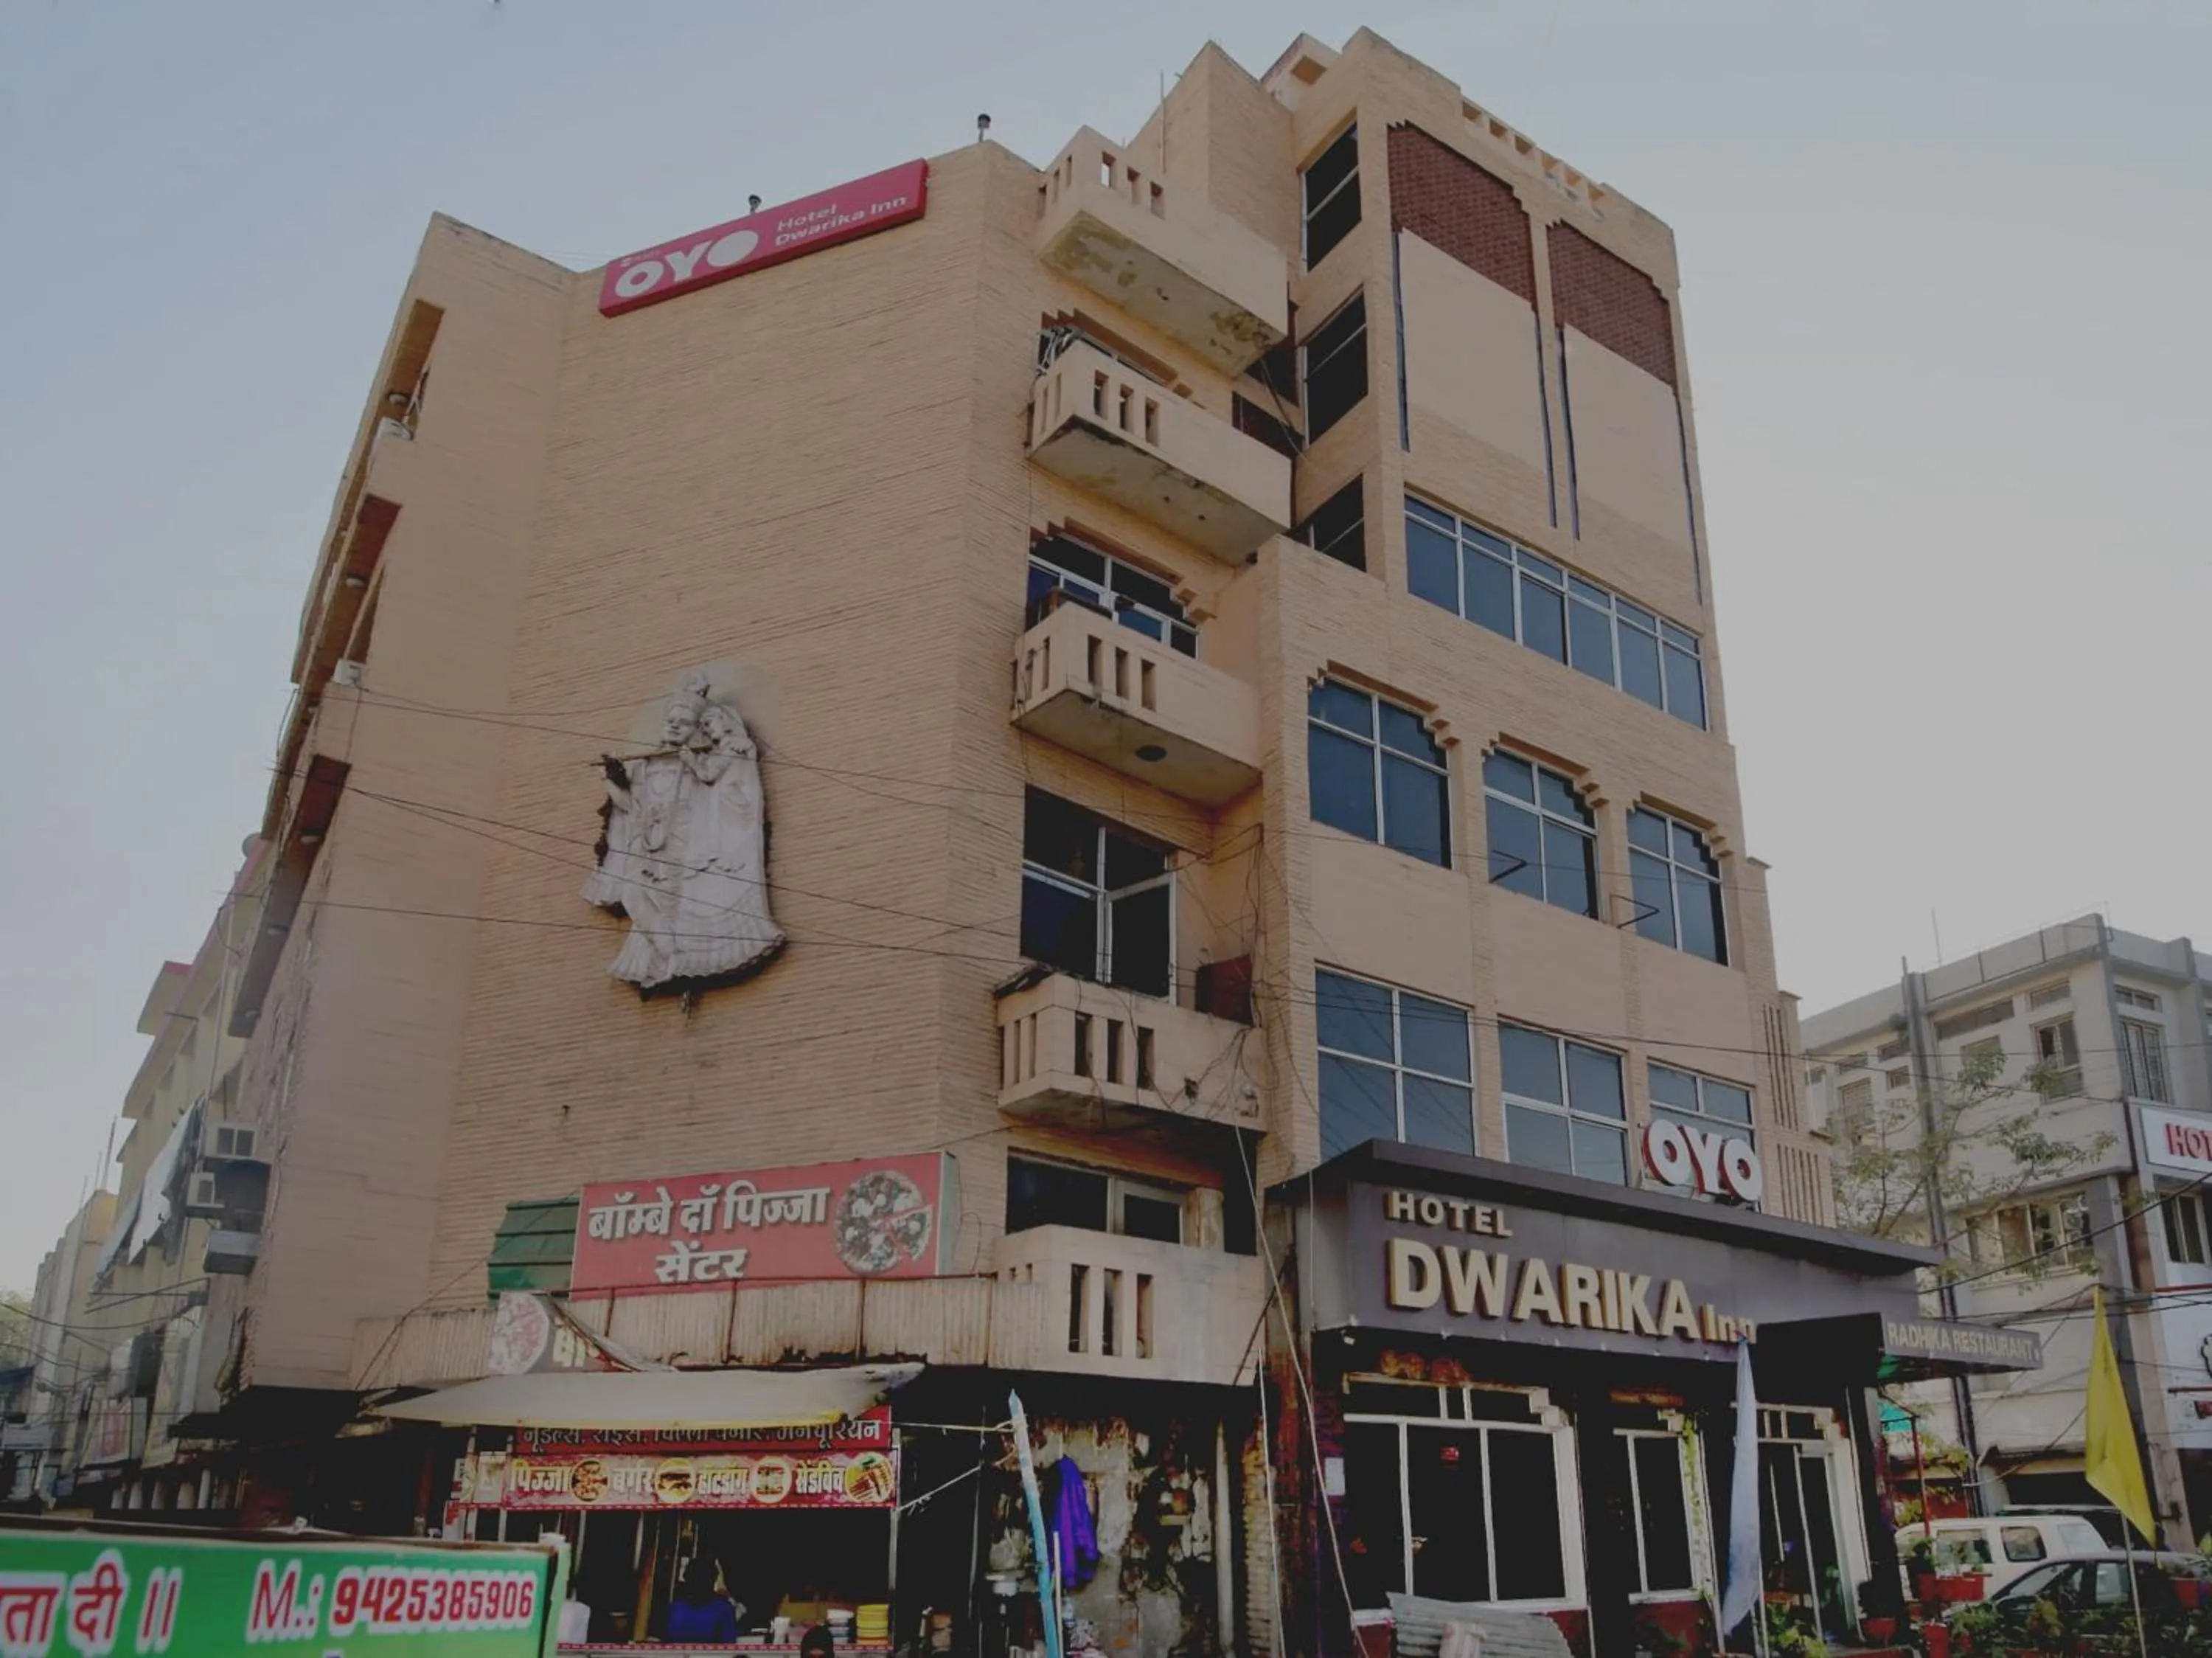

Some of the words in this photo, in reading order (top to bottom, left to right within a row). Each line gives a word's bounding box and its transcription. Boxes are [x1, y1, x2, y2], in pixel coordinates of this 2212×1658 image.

[778, 203, 838, 232] Hotel
[615, 230, 758, 297] OYO
[775, 210, 864, 246] Dwarika
[871, 196, 907, 215] Inn
[1643, 1119, 1763, 1202] OYO
[723, 1180, 830, 1229] पिज्जा
[1386, 1190, 1514, 1237] HOTEL
[654, 1240, 748, 1283] सेंटर
[1388, 1238, 1701, 1339] DWARIKA
[1886, 1322, 1952, 1350] RADHIKA
[1952, 1329, 2034, 1359] RESTAURANT
[74, 1563, 123, 1642] दी
[333, 1577, 534, 1626] 9425385906
